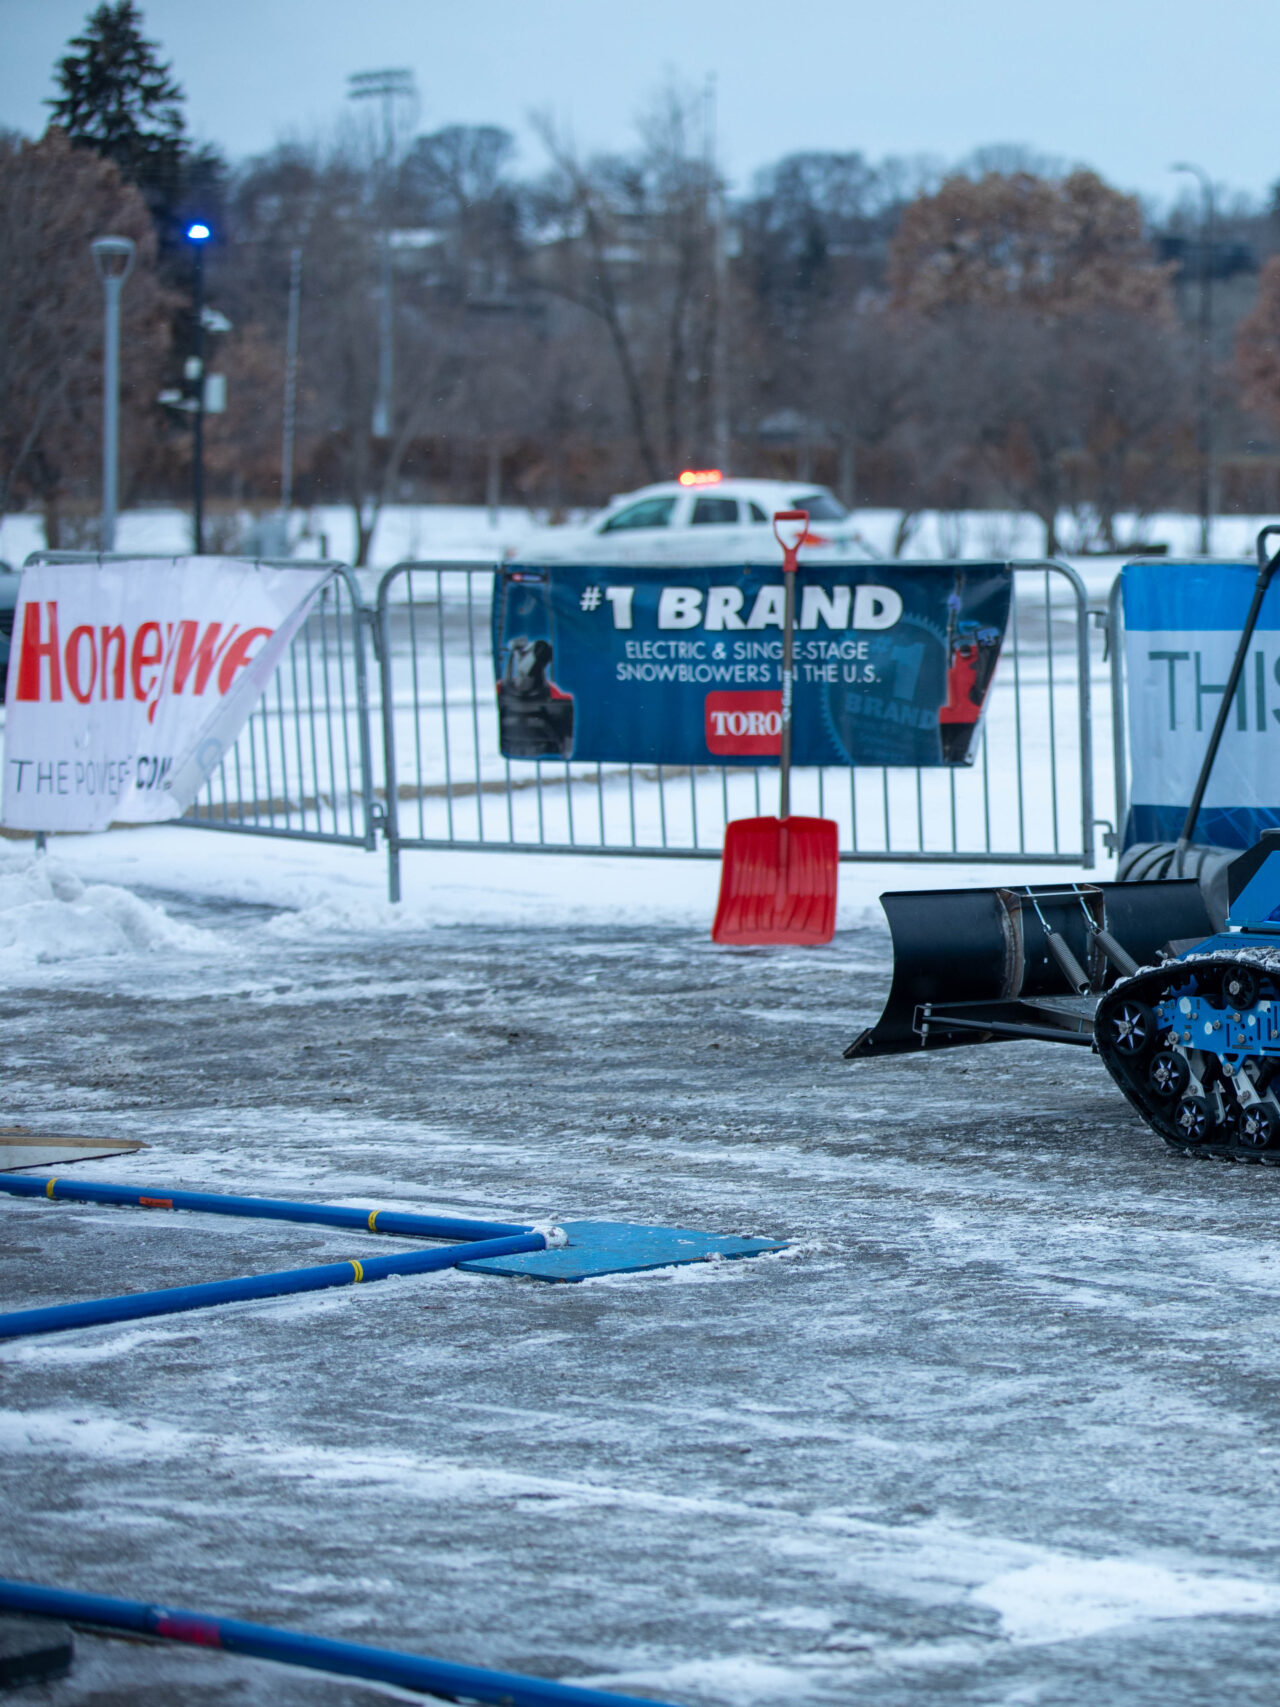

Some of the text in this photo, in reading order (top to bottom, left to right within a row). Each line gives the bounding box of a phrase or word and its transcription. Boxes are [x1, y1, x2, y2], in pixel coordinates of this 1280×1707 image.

[658, 585, 903, 631] BRAND
[625, 640, 869, 661] ELECTRIC & SINGE-STAGE
[616, 662, 771, 683] SNOWBLOWERS
[803, 664, 838, 683] THE
[843, 663, 882, 684] U.S.
[710, 710, 783, 737] TORO
[9, 759, 69, 795] THE
